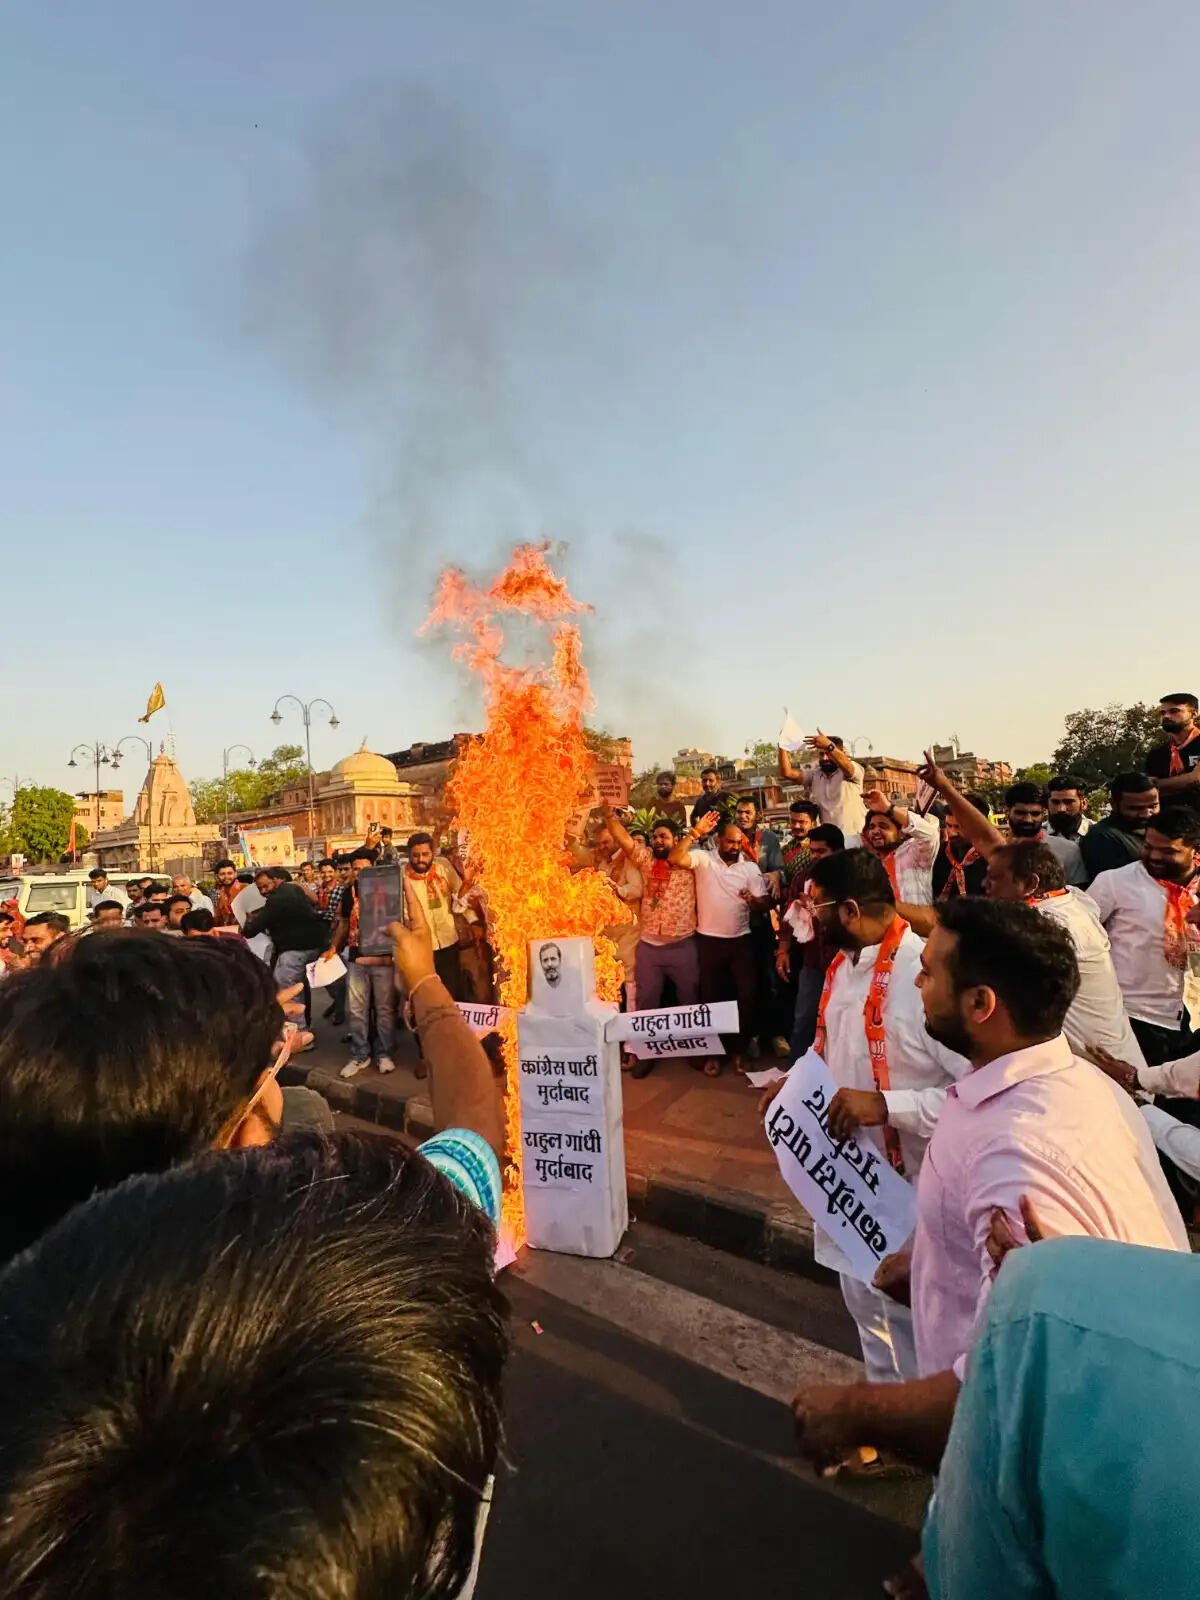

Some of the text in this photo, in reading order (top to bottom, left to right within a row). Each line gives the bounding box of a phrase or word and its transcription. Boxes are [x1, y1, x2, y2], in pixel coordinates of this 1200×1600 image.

[473, 1006, 500, 1027] पार्टी
[632, 1004, 712, 1037] राहुल गांधी
[520, 1055, 598, 1077] कांग्रेस पार्टी
[523, 1129, 602, 1153] राहुल गांधी
[768, 1104, 887, 1261] कांग्रेस पार्टी
